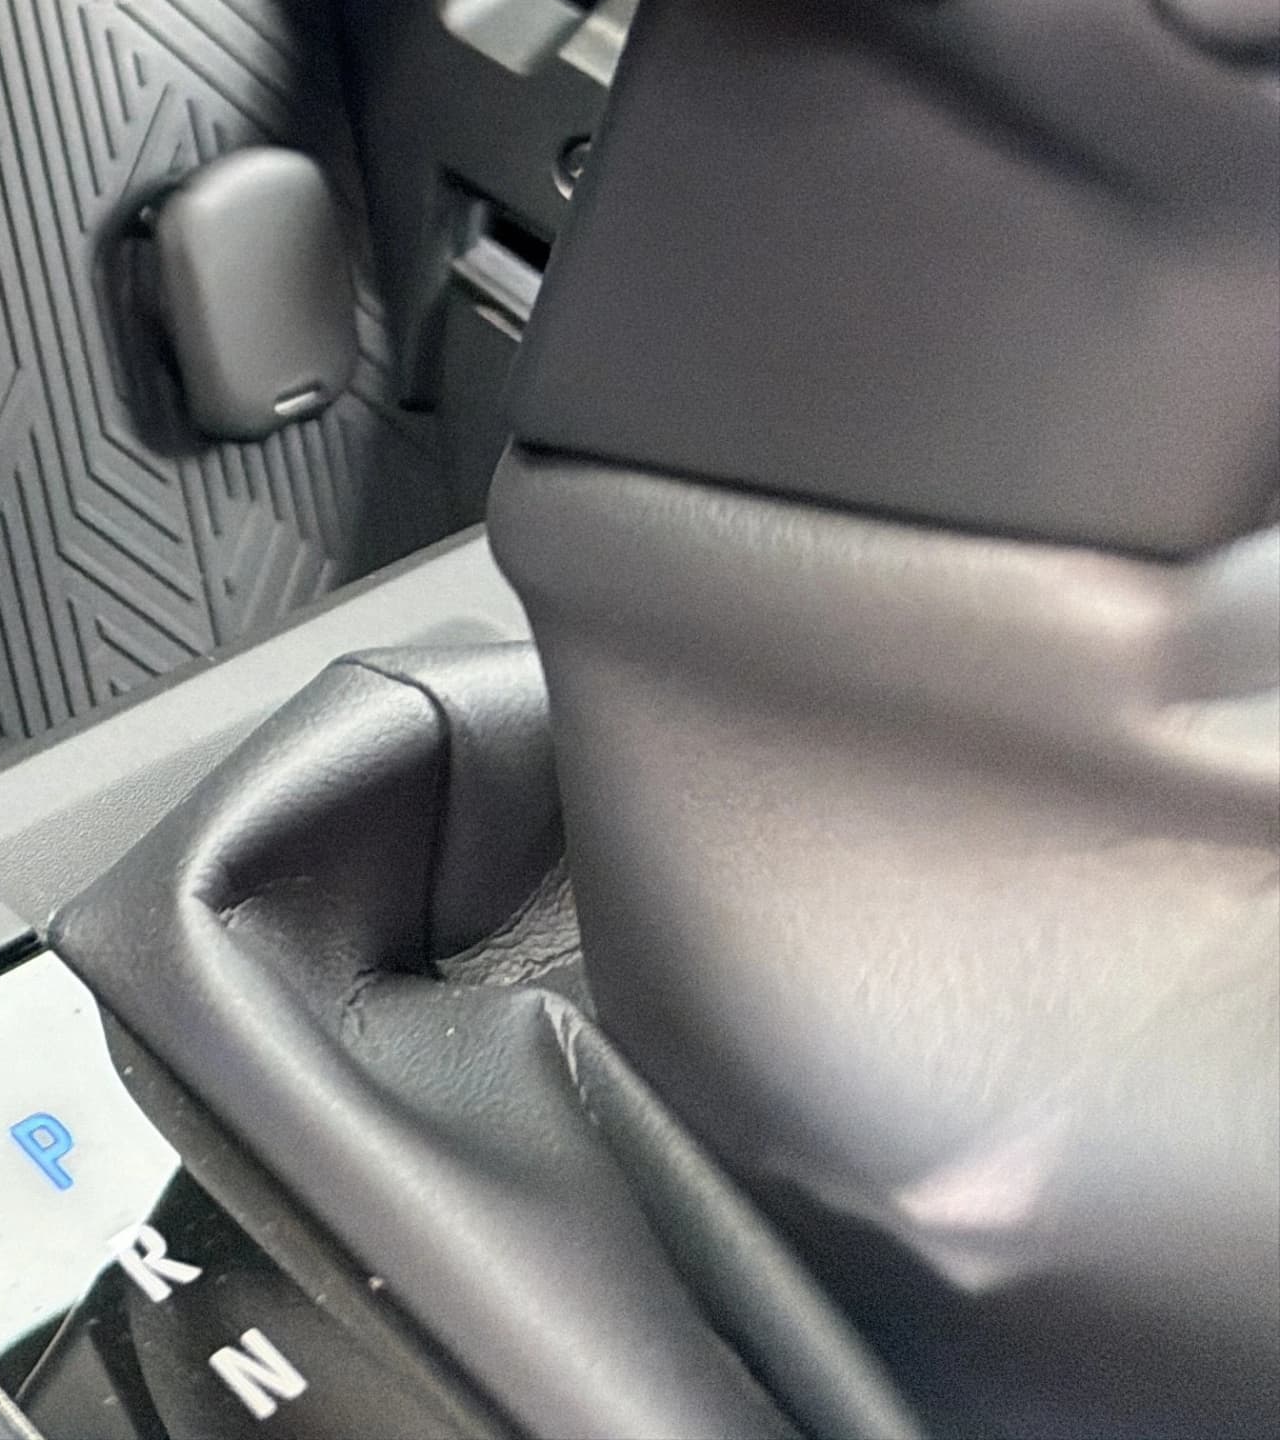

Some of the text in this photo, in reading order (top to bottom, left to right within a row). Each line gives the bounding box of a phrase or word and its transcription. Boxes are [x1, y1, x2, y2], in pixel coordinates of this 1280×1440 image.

[10, 1112, 75, 1191] P
[106, 1223, 203, 1303] R
[208, 1327, 308, 1421] N
